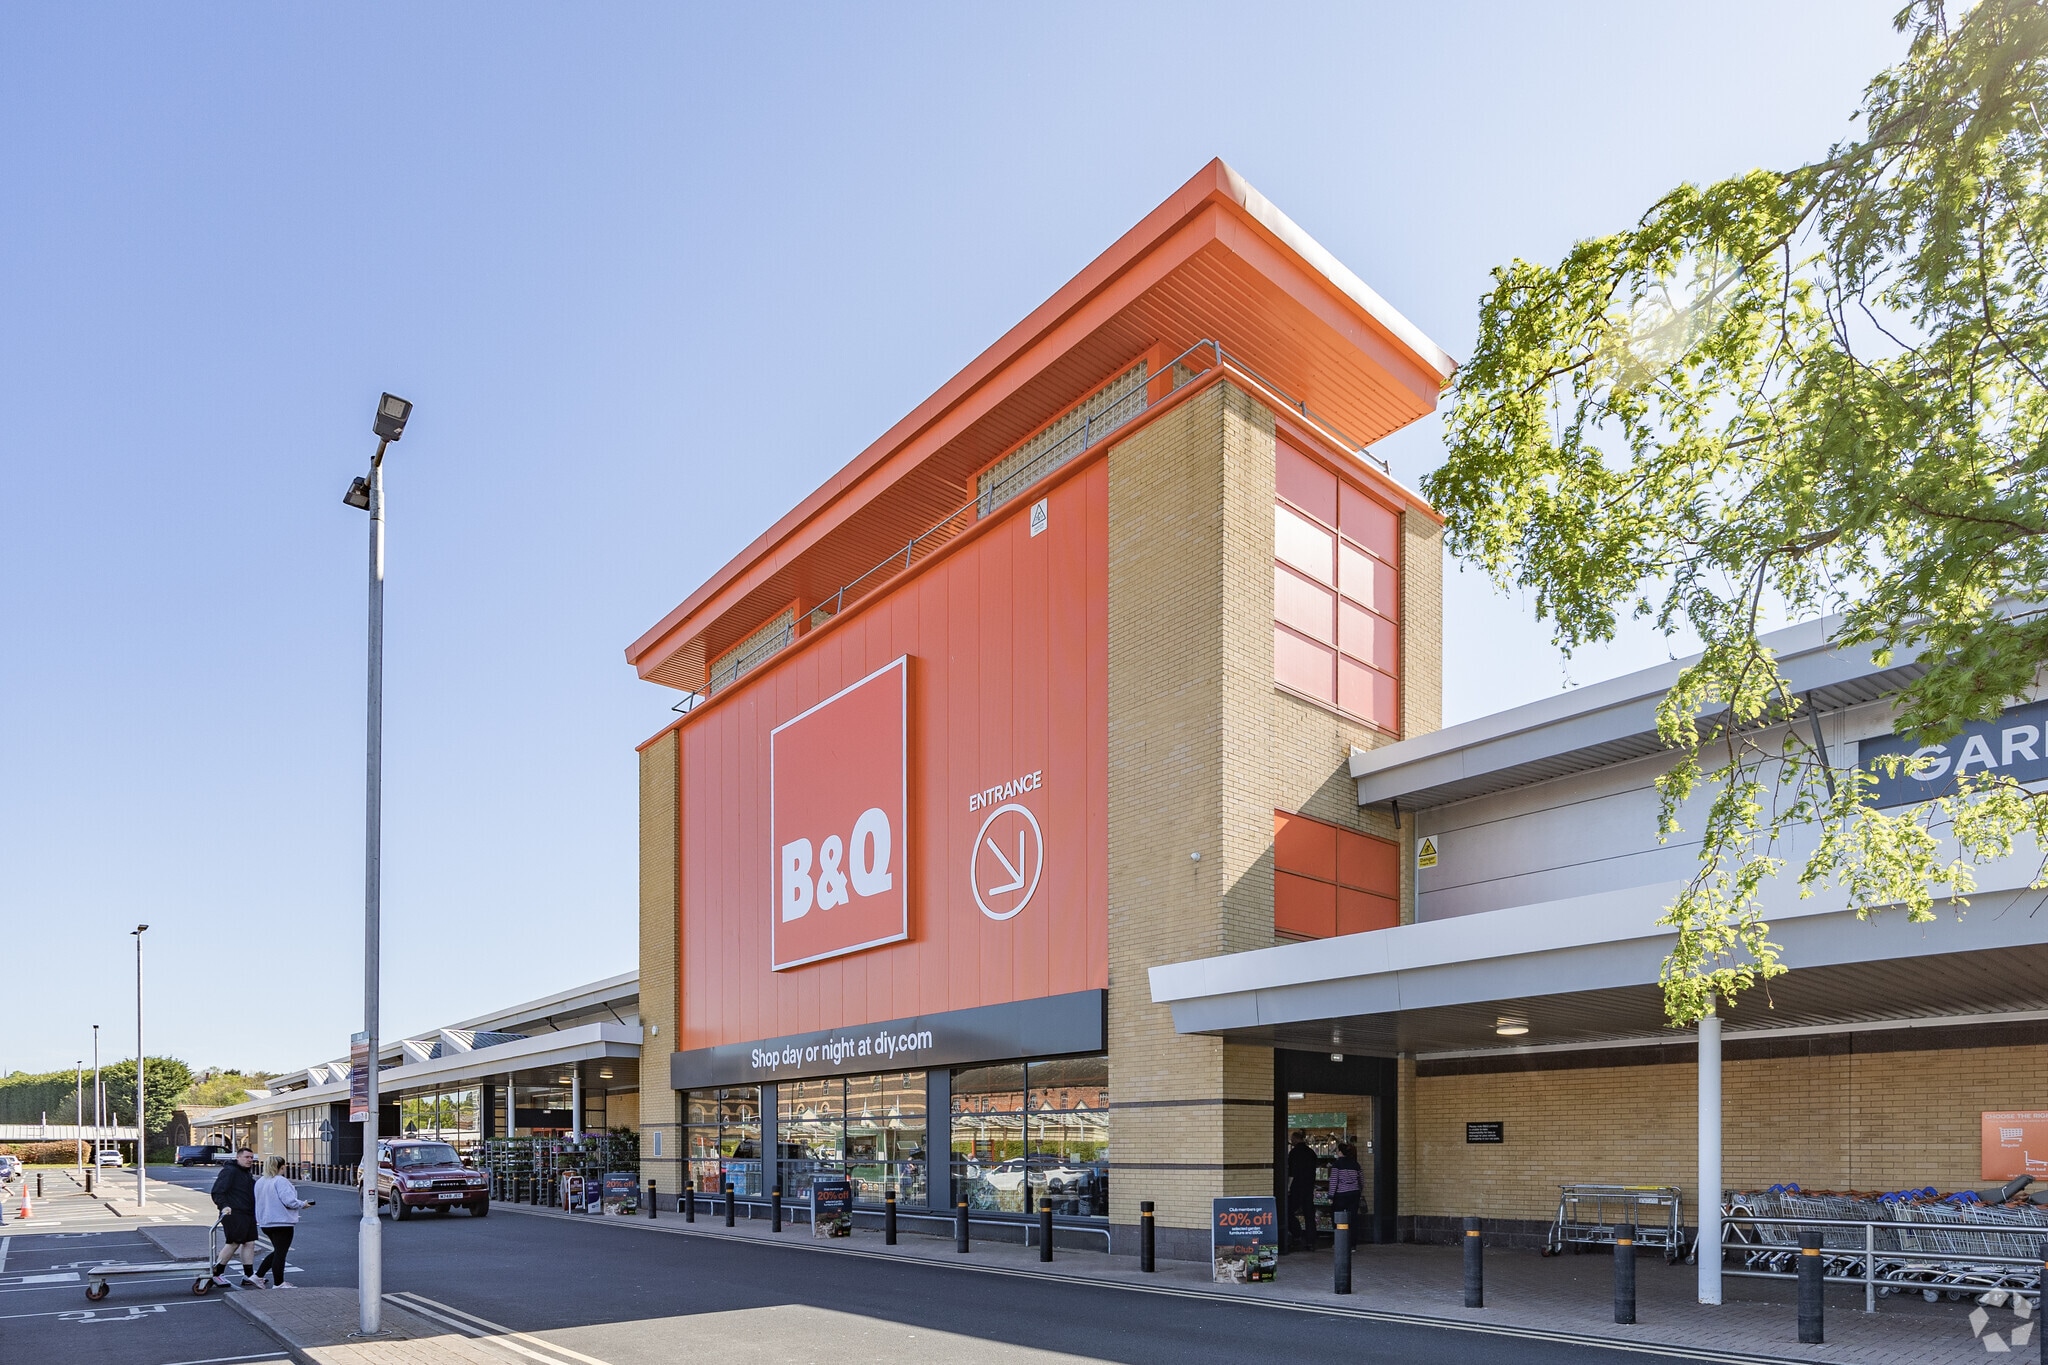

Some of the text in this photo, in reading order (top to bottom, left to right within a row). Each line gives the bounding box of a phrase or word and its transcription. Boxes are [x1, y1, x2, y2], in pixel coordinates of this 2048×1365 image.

[1908, 720, 2048, 782] GAR
[968, 769, 1043, 813] ENTRANCE
[781, 806, 893, 923] B&Q
[751, 1030, 933, 1072] Shop day or night at diy.com
[817, 1191, 849, 1201] 20% off
[1219, 1212, 1273, 1226] 20% off
[1235, 1245, 1254, 1253] Club
